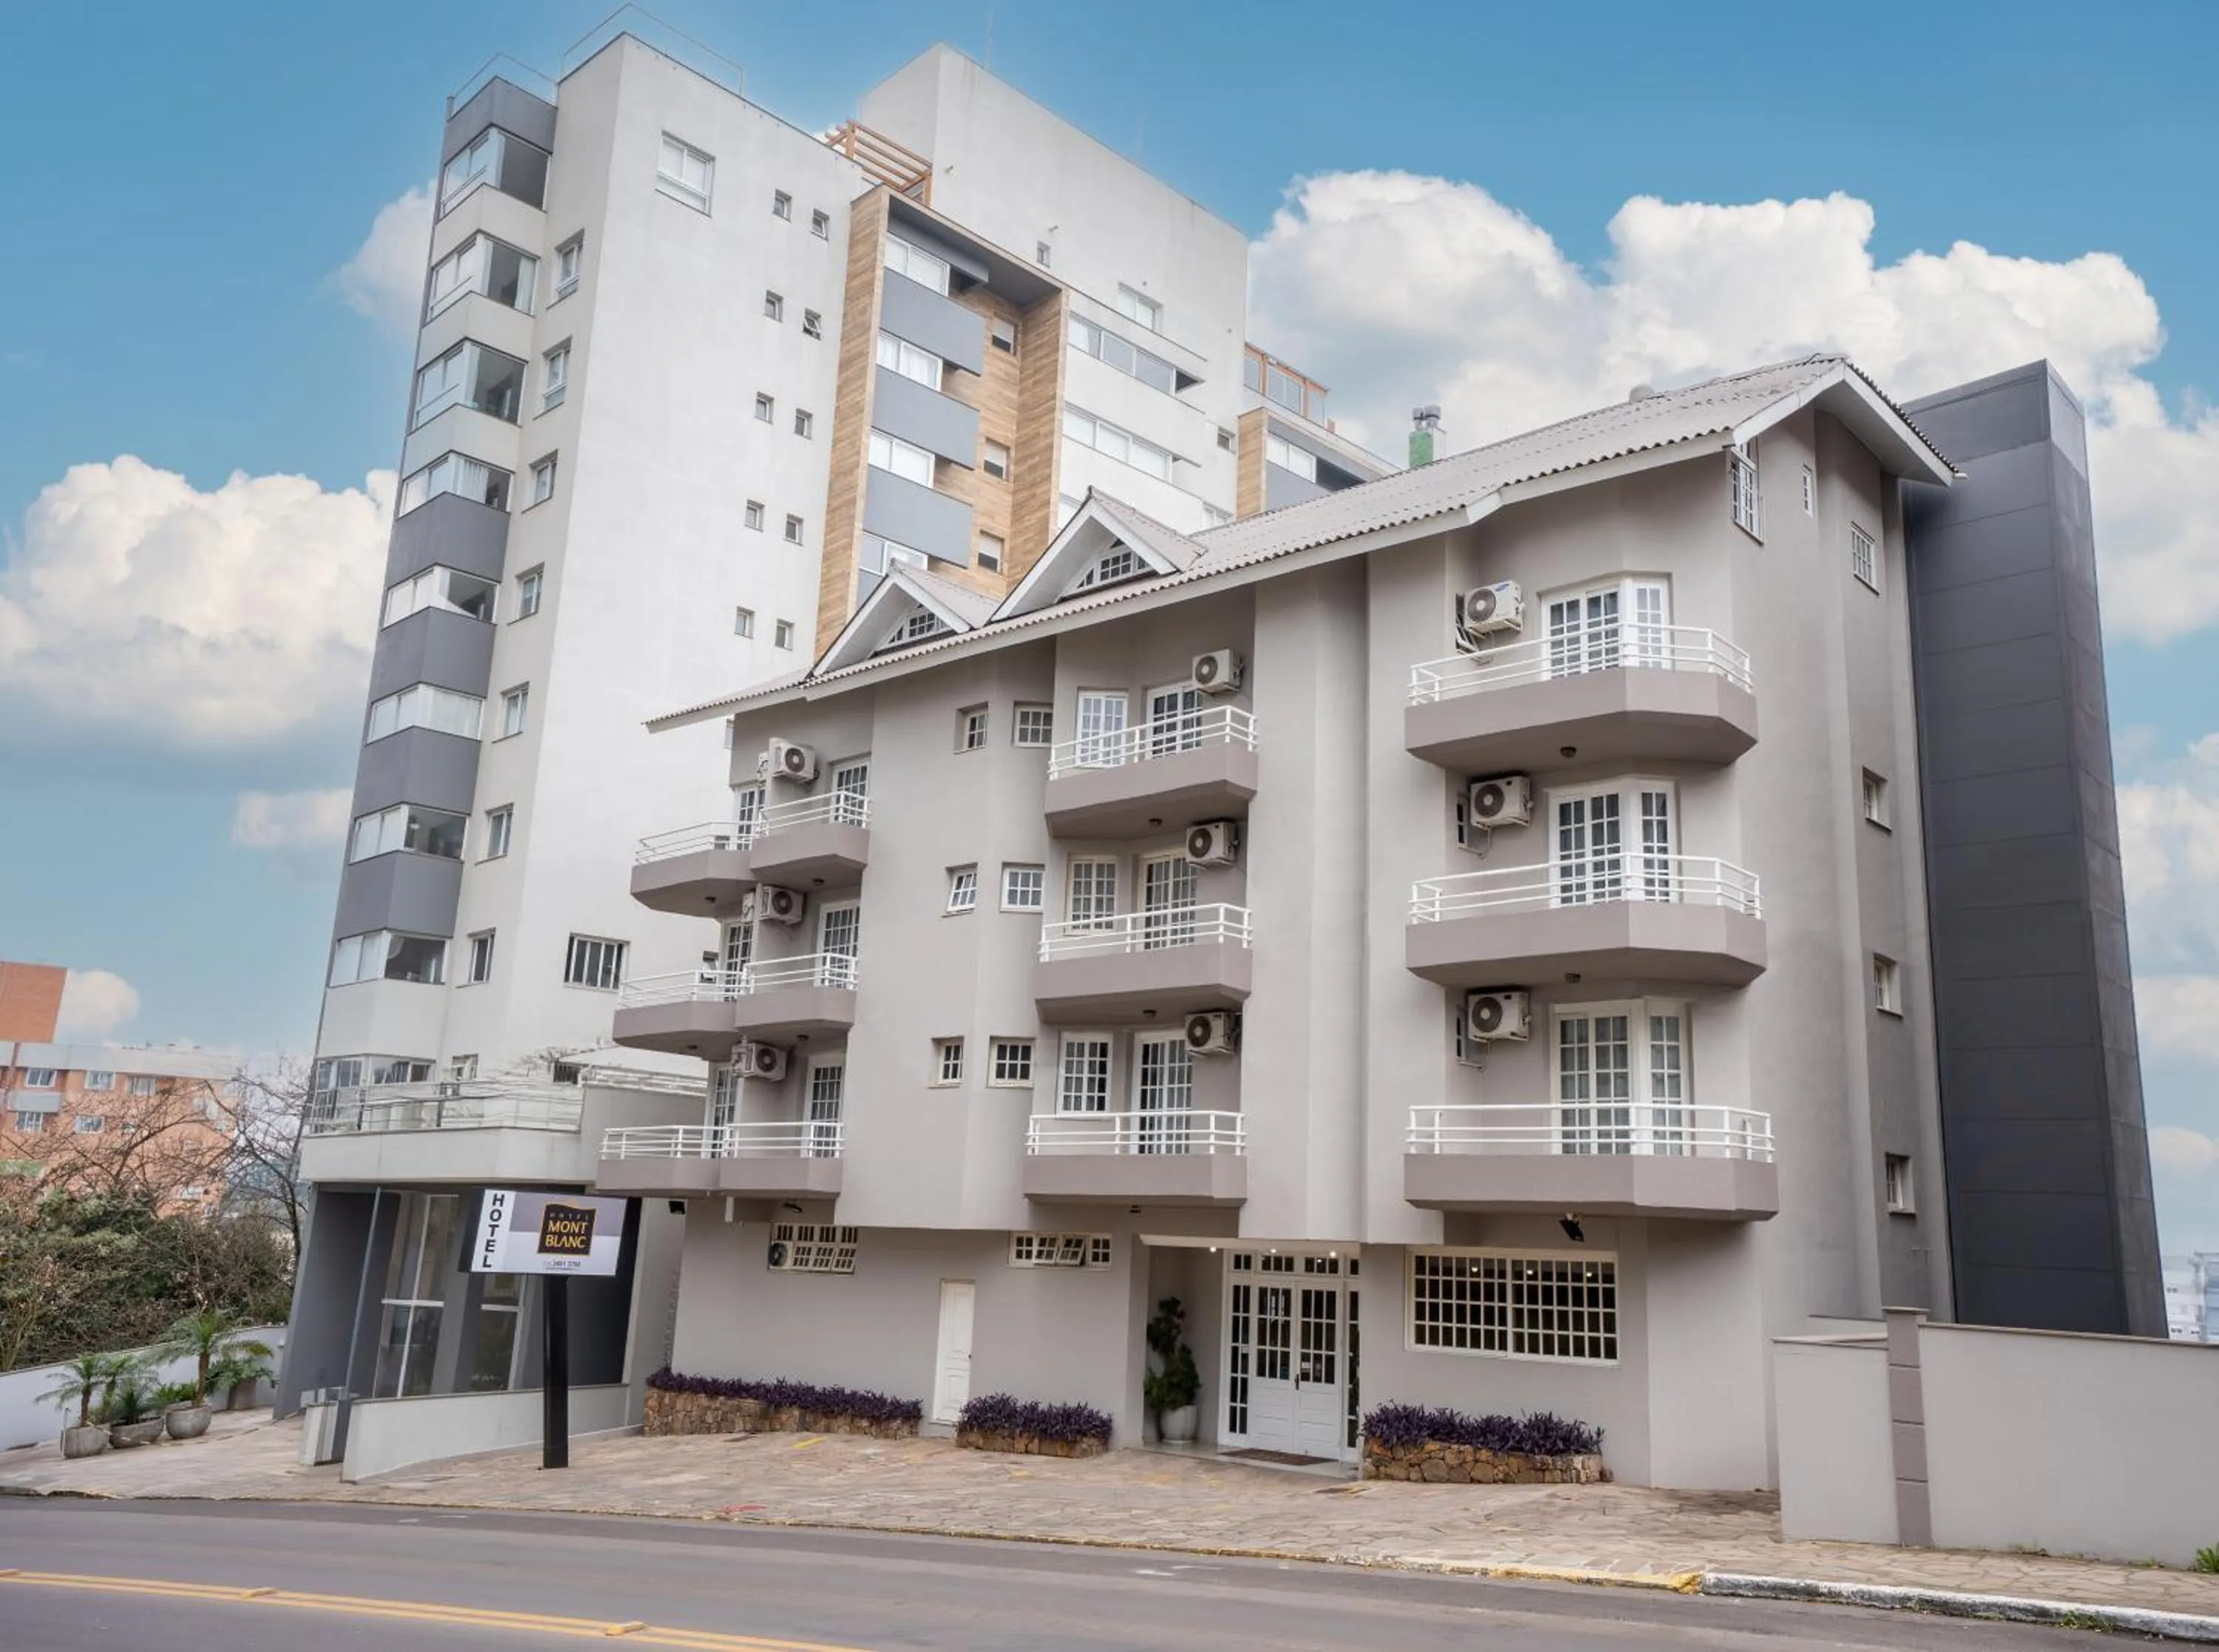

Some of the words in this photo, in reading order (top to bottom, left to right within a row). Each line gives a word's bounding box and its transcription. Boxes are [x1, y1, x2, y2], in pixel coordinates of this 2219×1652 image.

[482, 1193, 505, 1268] HOTEL
[548, 1219, 589, 1234] MONT
[545, 1234, 587, 1249] BLANC
